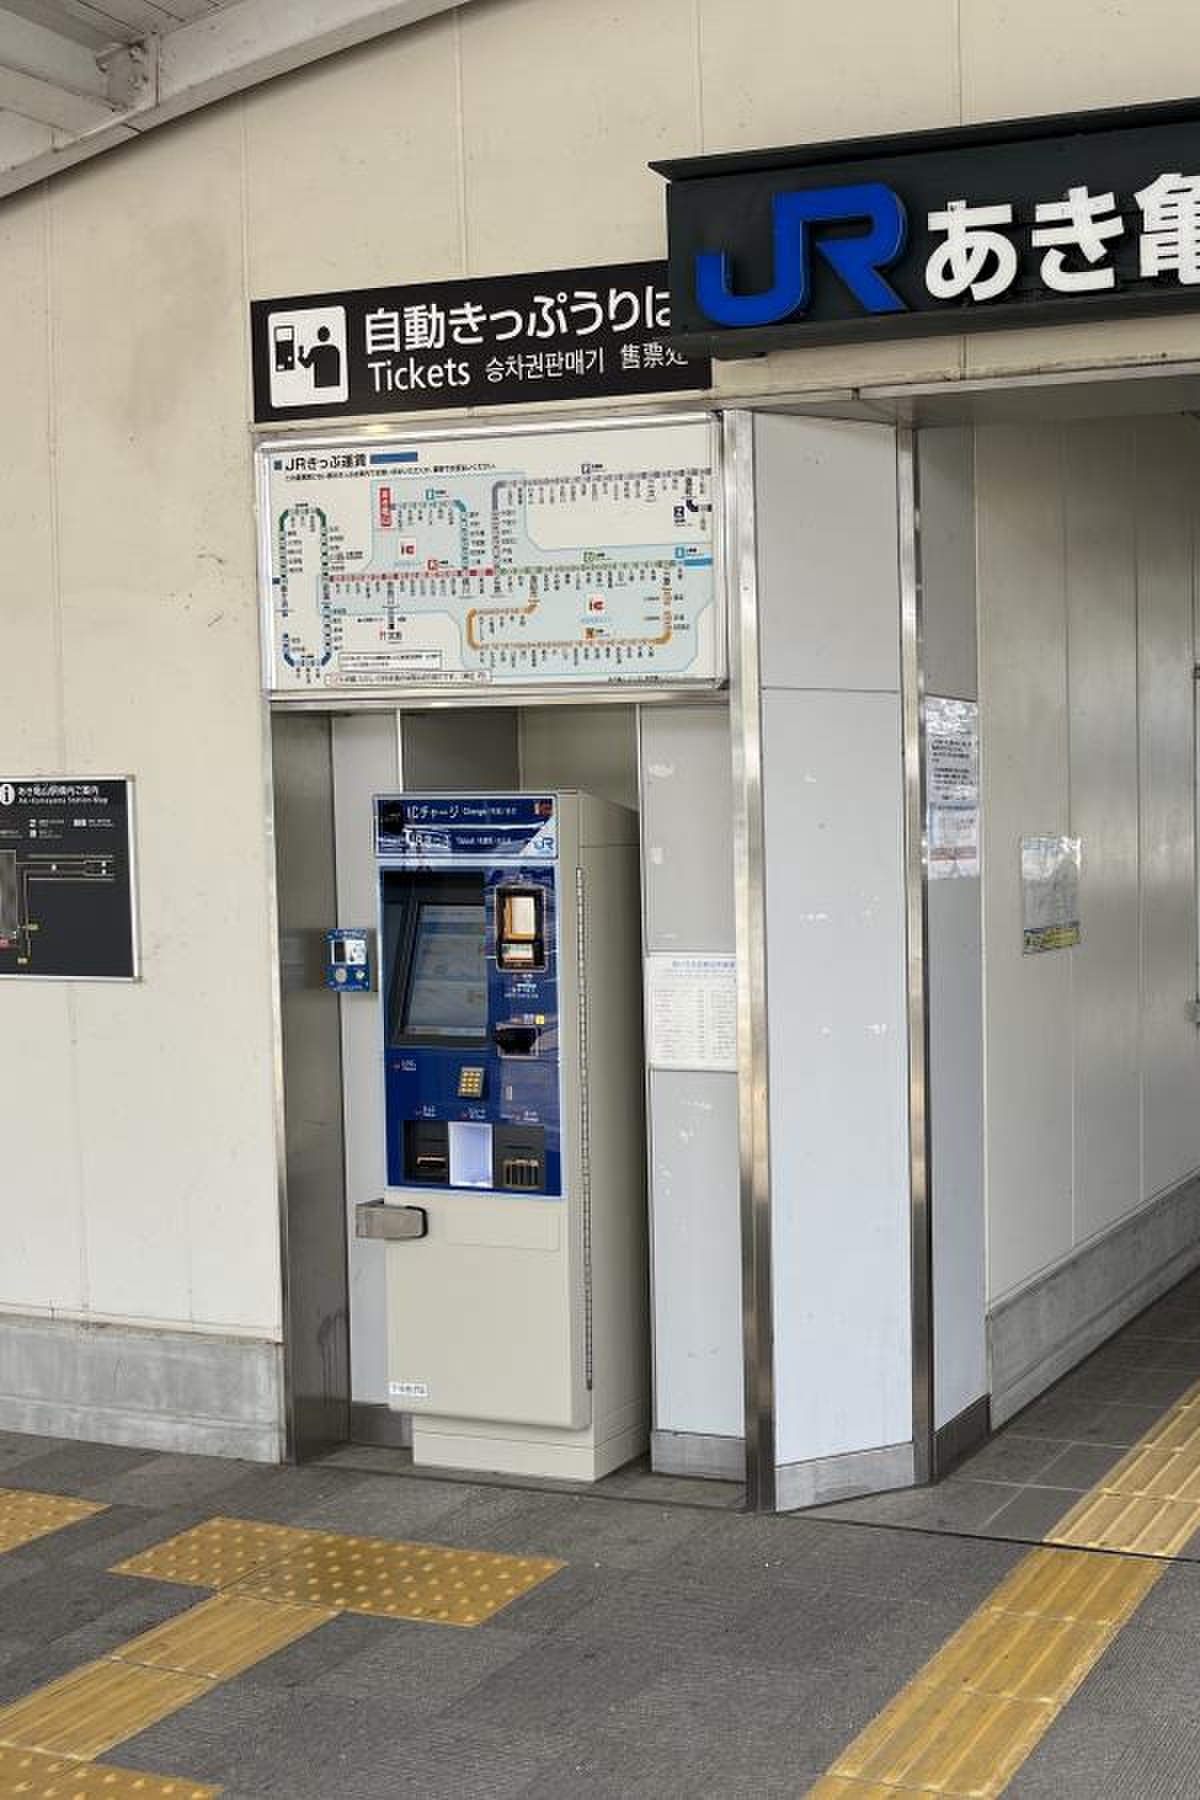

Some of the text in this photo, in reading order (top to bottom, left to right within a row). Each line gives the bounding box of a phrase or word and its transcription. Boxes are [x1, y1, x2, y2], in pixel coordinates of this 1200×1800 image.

[695, 183, 907, 327] JR
[367, 358, 471, 393] Tickets
[485, 346, 605, 384] 승차권판매기
